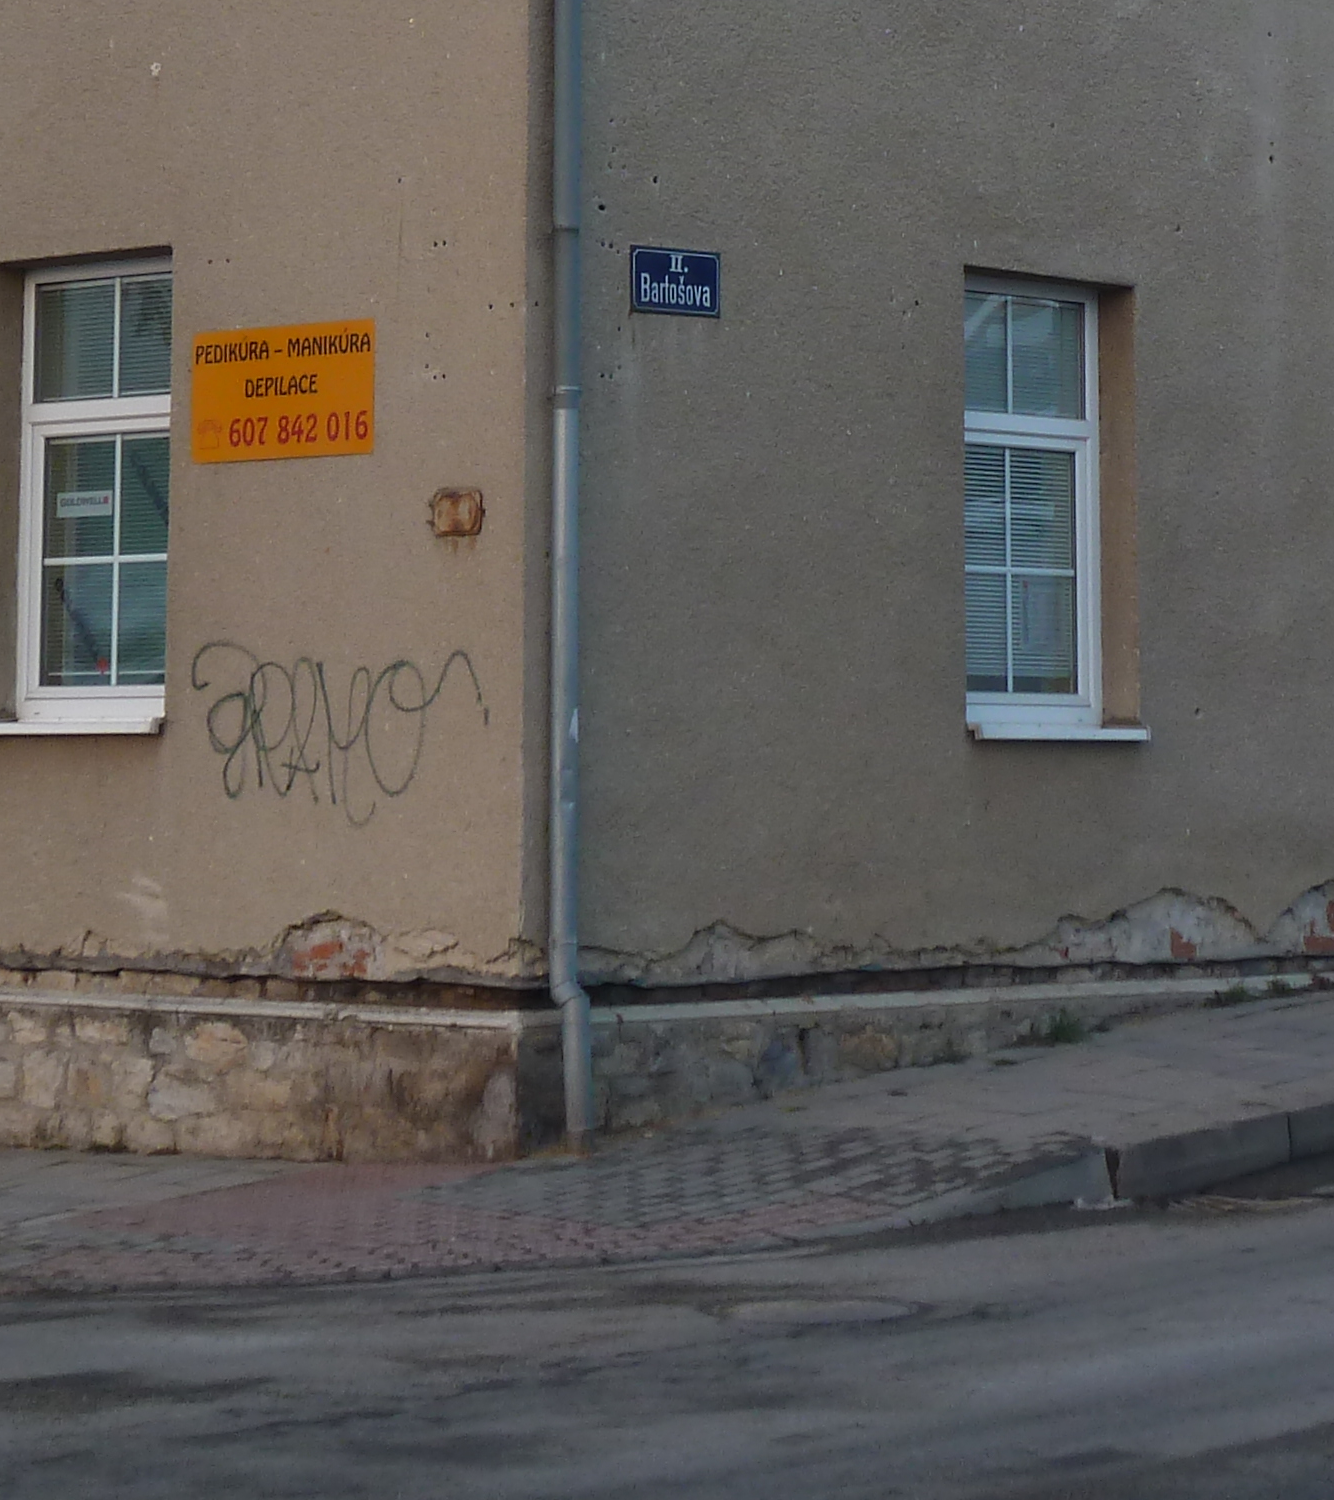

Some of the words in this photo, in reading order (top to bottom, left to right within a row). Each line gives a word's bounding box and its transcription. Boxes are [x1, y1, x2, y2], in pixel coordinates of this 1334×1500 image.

[669, 254, 689, 273] II.
[640, 272, 711, 308] Bartošova
[195, 336, 270, 365] PEDIKÚRA
[287, 327, 371, 358] MANIKÚRA
[245, 373, 318, 398] DEPILACE
[228, 416, 269, 448] 607
[277, 413, 318, 445] 842
[326, 409, 369, 442] 016
